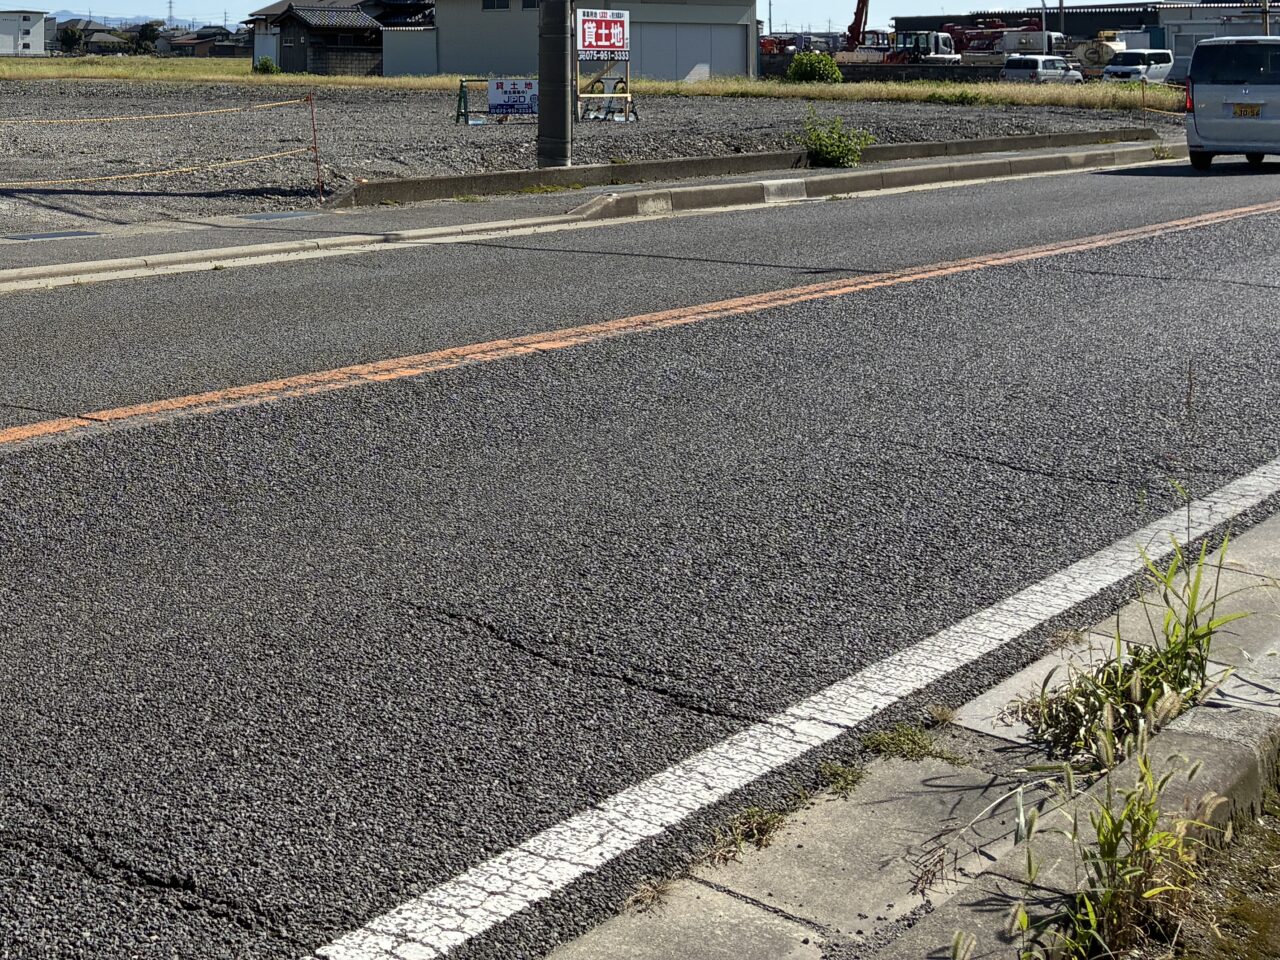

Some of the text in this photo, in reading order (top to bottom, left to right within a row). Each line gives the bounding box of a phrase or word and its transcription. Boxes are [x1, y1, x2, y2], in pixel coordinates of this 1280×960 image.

[584, 21, 623, 47] 貸土地
[586, 51, 629, 60] 075-951-3333
[496, 81, 533, 90] 貸土地
